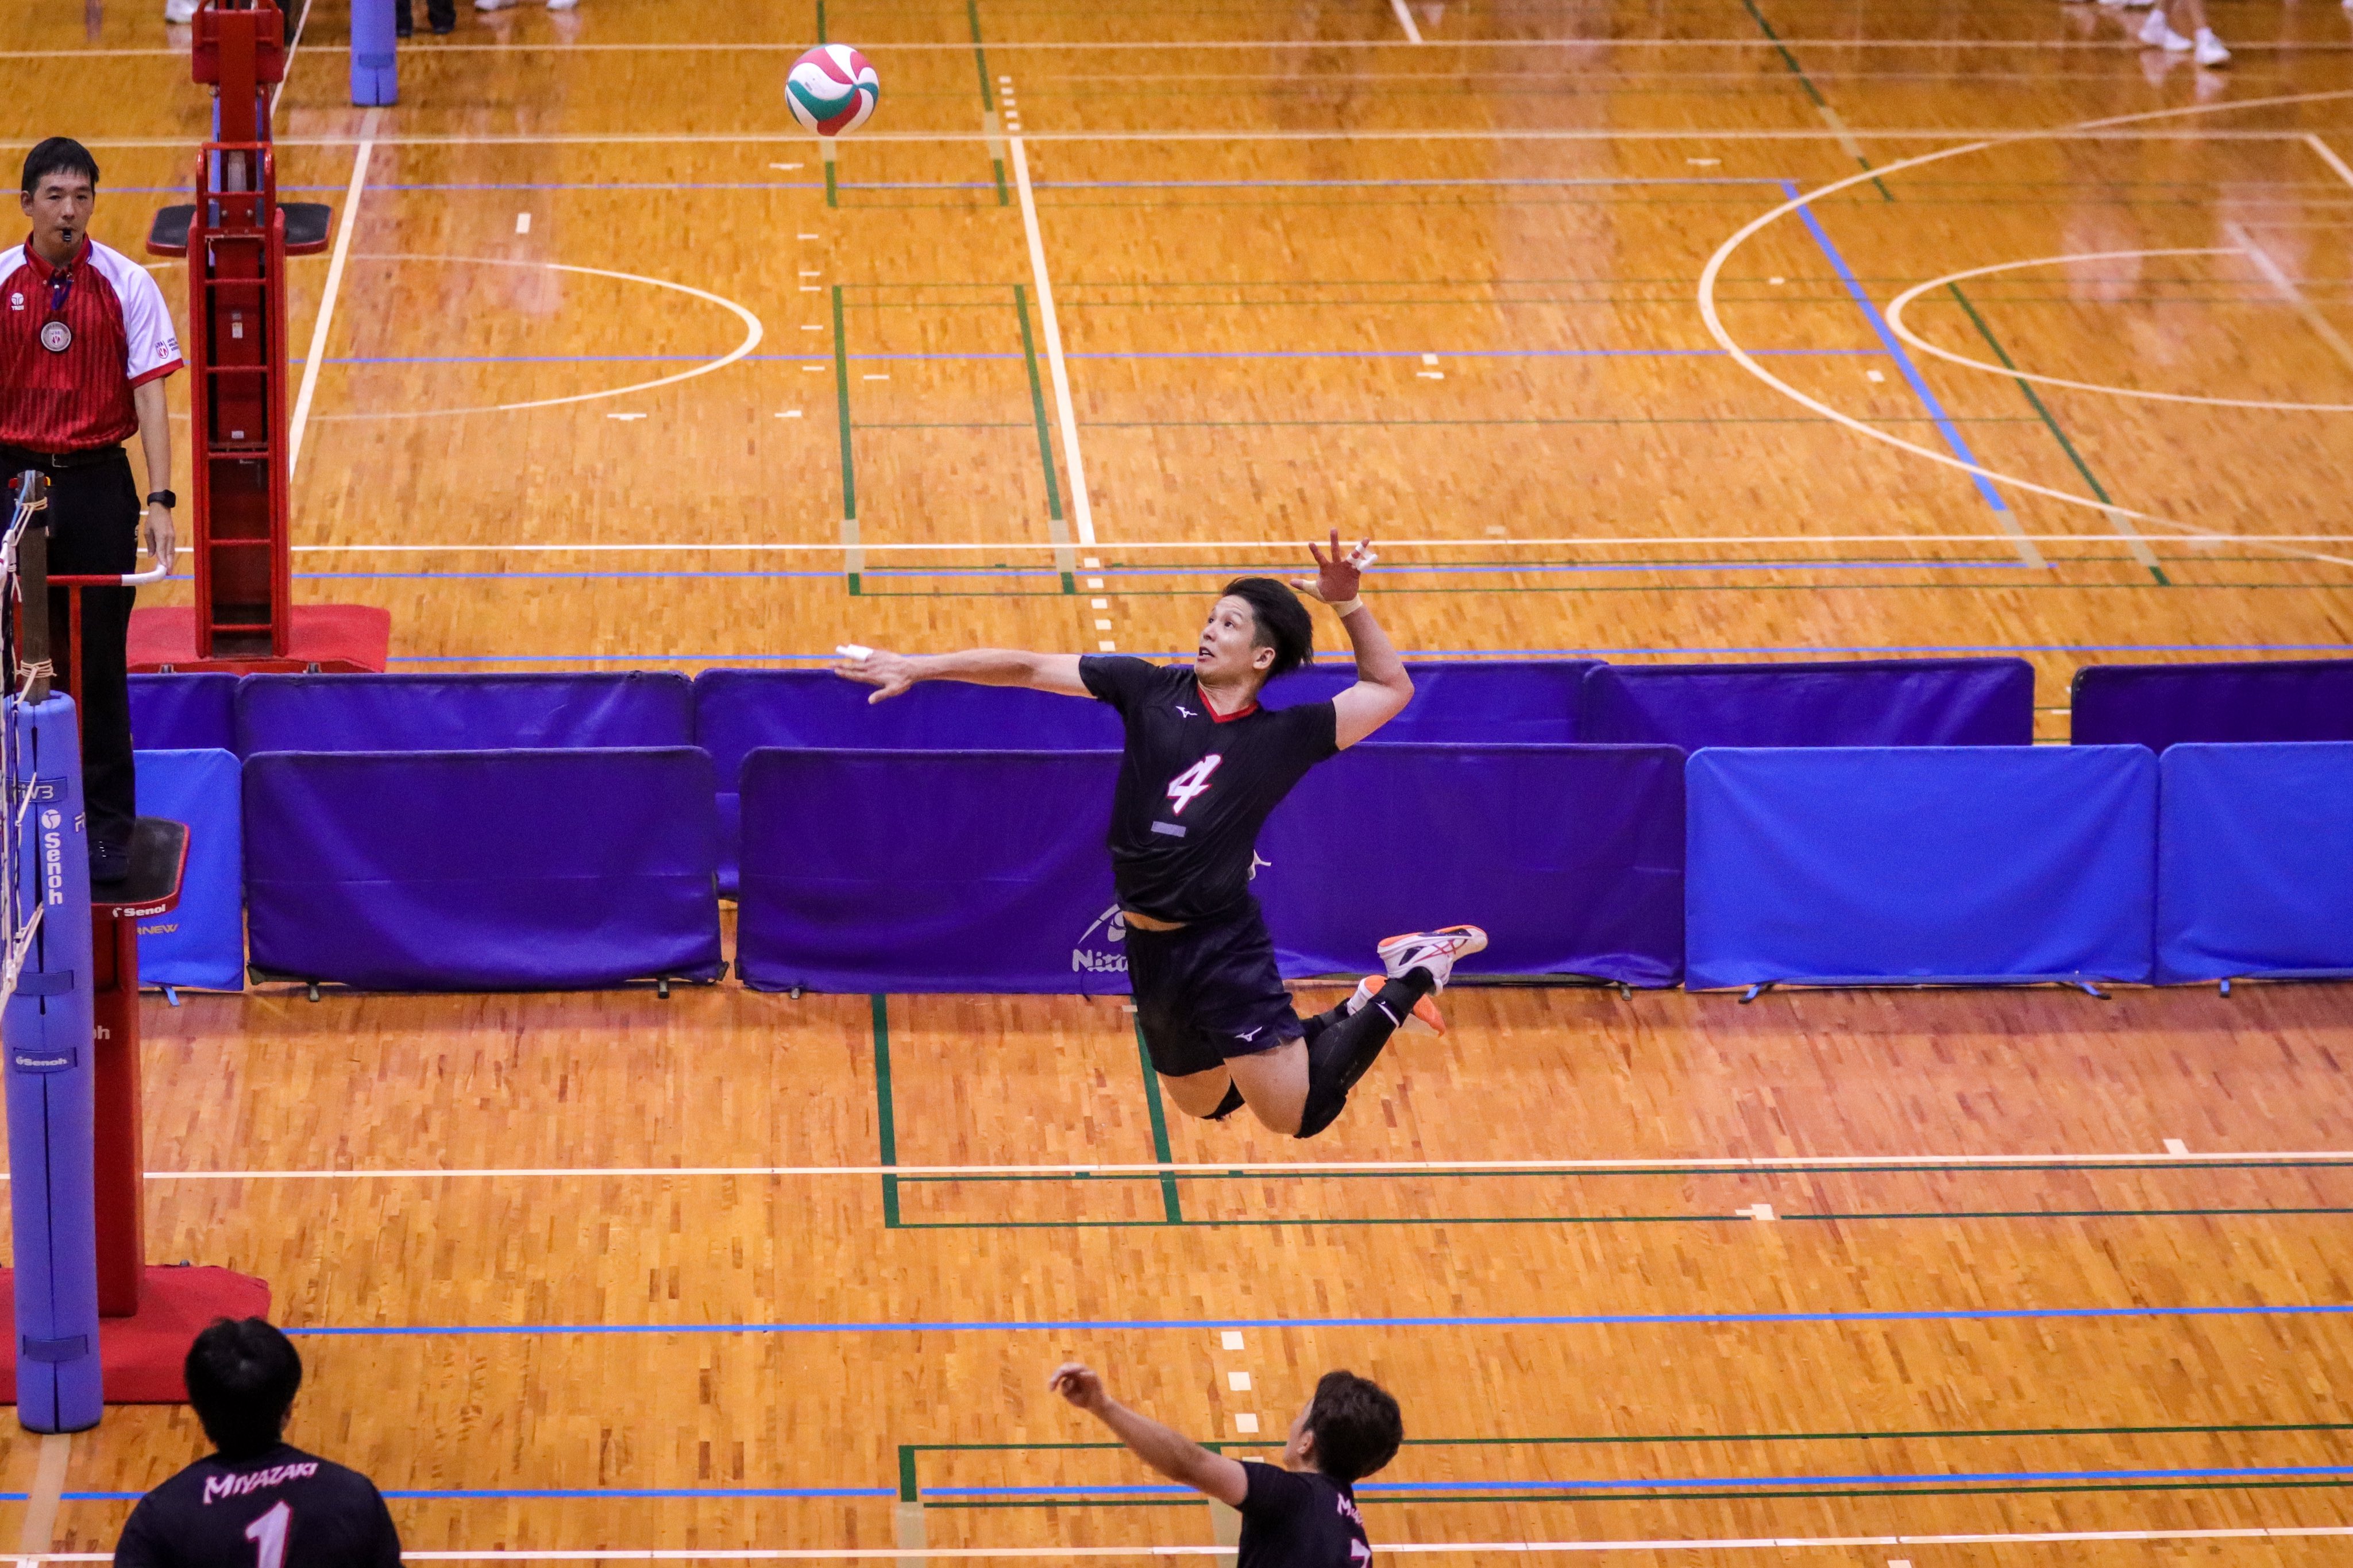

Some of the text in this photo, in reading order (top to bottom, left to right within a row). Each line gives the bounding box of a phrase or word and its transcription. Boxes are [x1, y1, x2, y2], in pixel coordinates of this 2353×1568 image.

[1166, 754, 1223, 817] 4
[44, 832, 63, 905] Senoh
[1072, 949, 1128, 972] Nitt
[203, 1462, 318, 1504] MIYAZAKI
[244, 1499, 294, 1568] 1
